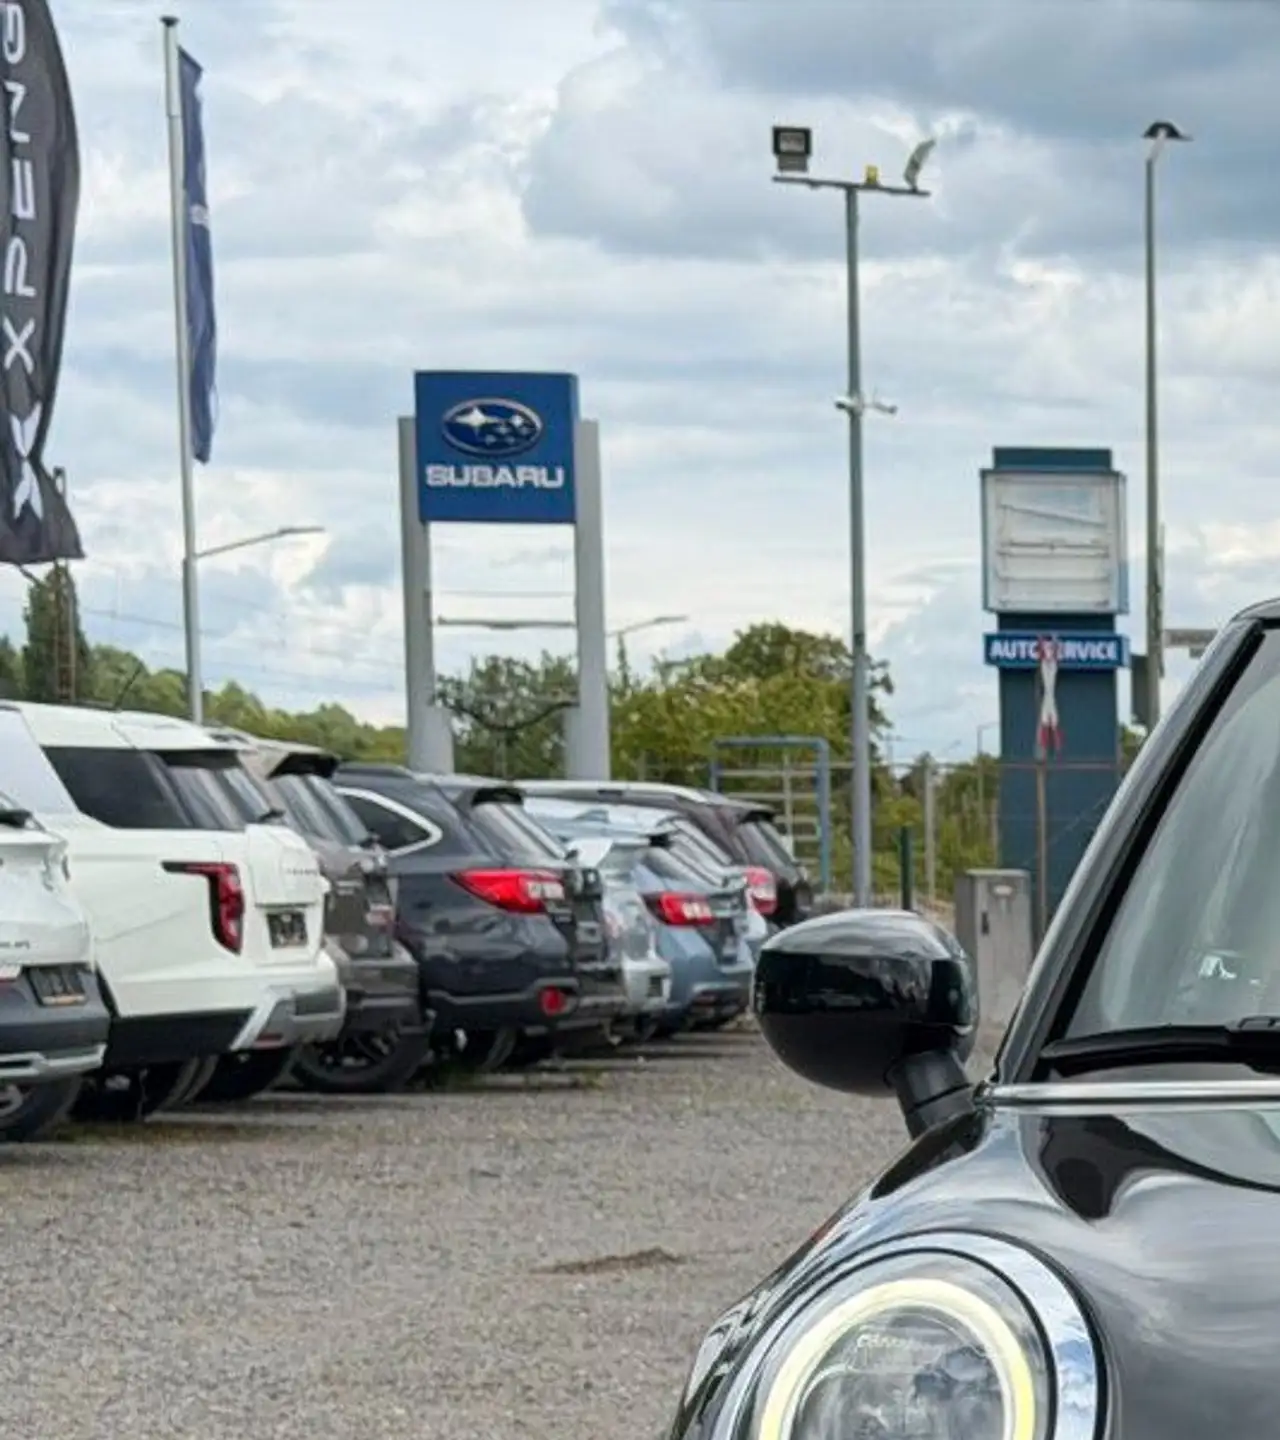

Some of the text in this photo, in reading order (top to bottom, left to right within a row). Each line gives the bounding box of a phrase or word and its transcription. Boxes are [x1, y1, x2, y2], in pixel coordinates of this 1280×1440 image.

[2, 3, 36, 375] XPENG
[426, 464, 565, 488] SUBARU
[989, 639, 1118, 661] AUTOERVICE
